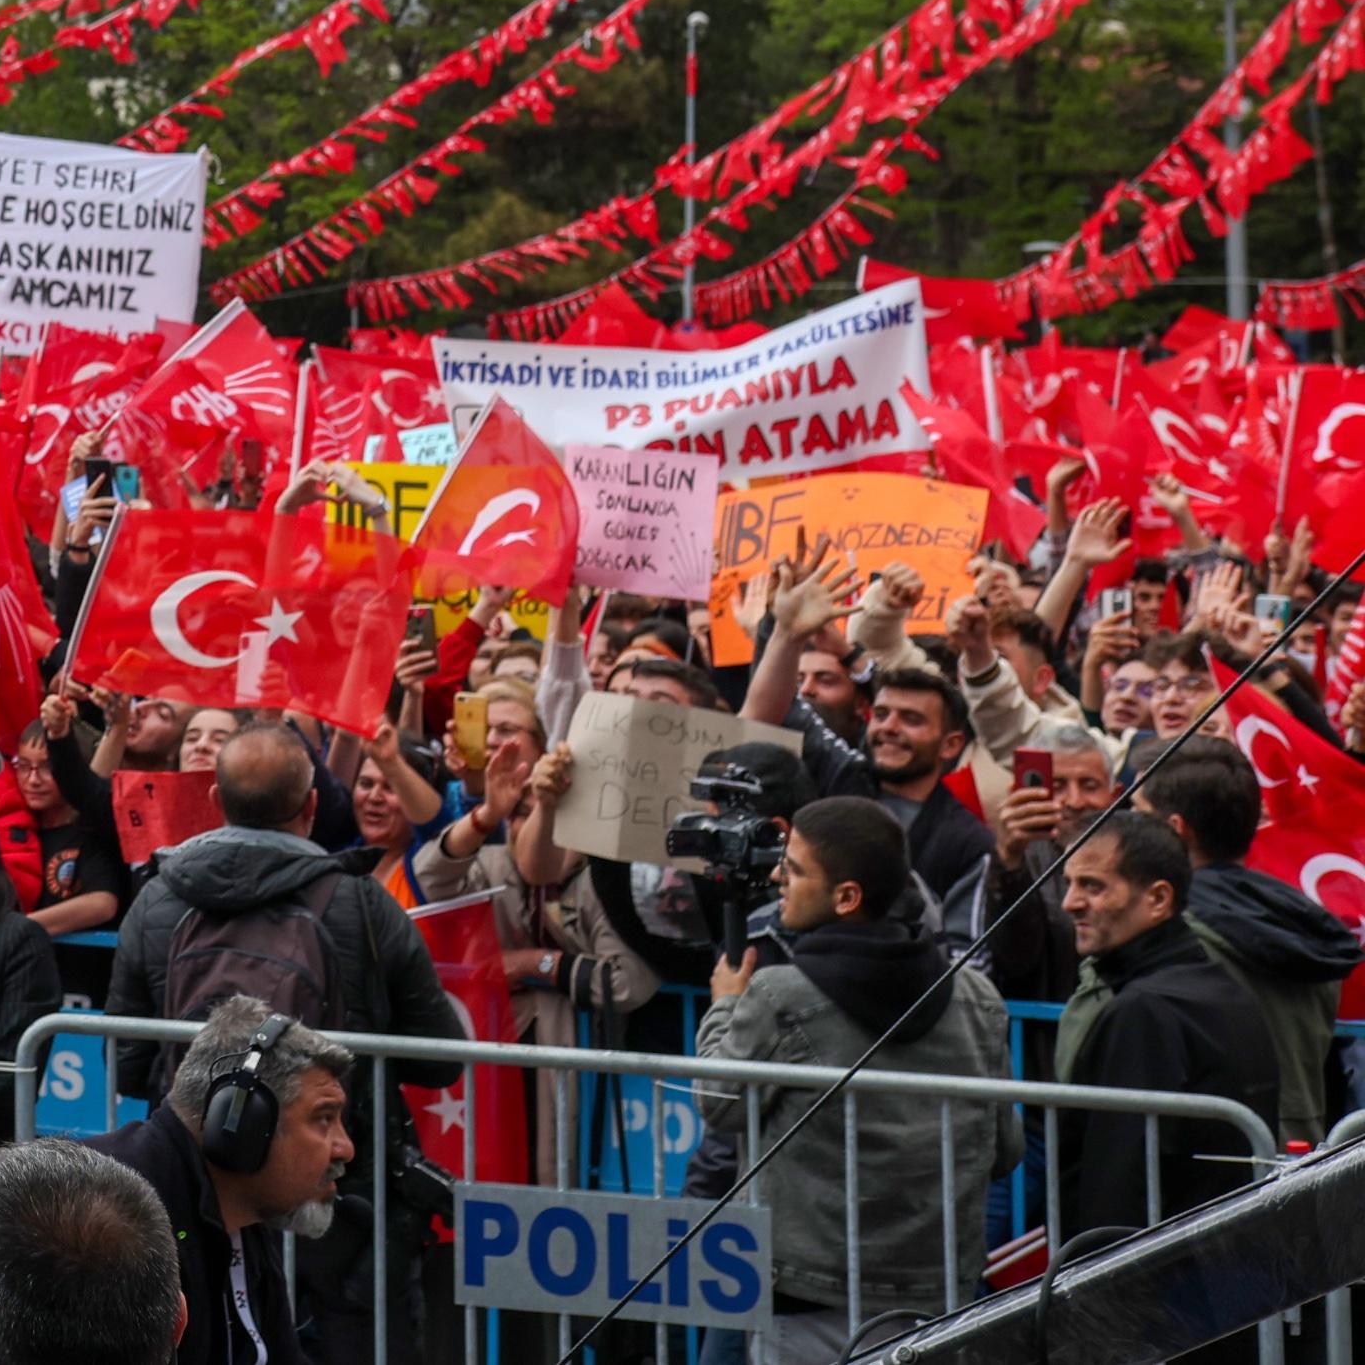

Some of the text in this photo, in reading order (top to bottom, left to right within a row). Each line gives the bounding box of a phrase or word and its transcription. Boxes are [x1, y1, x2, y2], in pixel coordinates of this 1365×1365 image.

[55, 164, 137, 193] ŞEHRİ
[24, 198, 196, 232] HOŞGELDİNİZ
[10, 275, 139, 313] AMCAMIZ
[442, 298, 917, 390] İKTİSADİ VE İDARİ BİLİMLER FAKÜLTESİNE
[605, 355, 857, 431] P3 PUANIYLA
[739, 398, 901, 466] ATAMA
